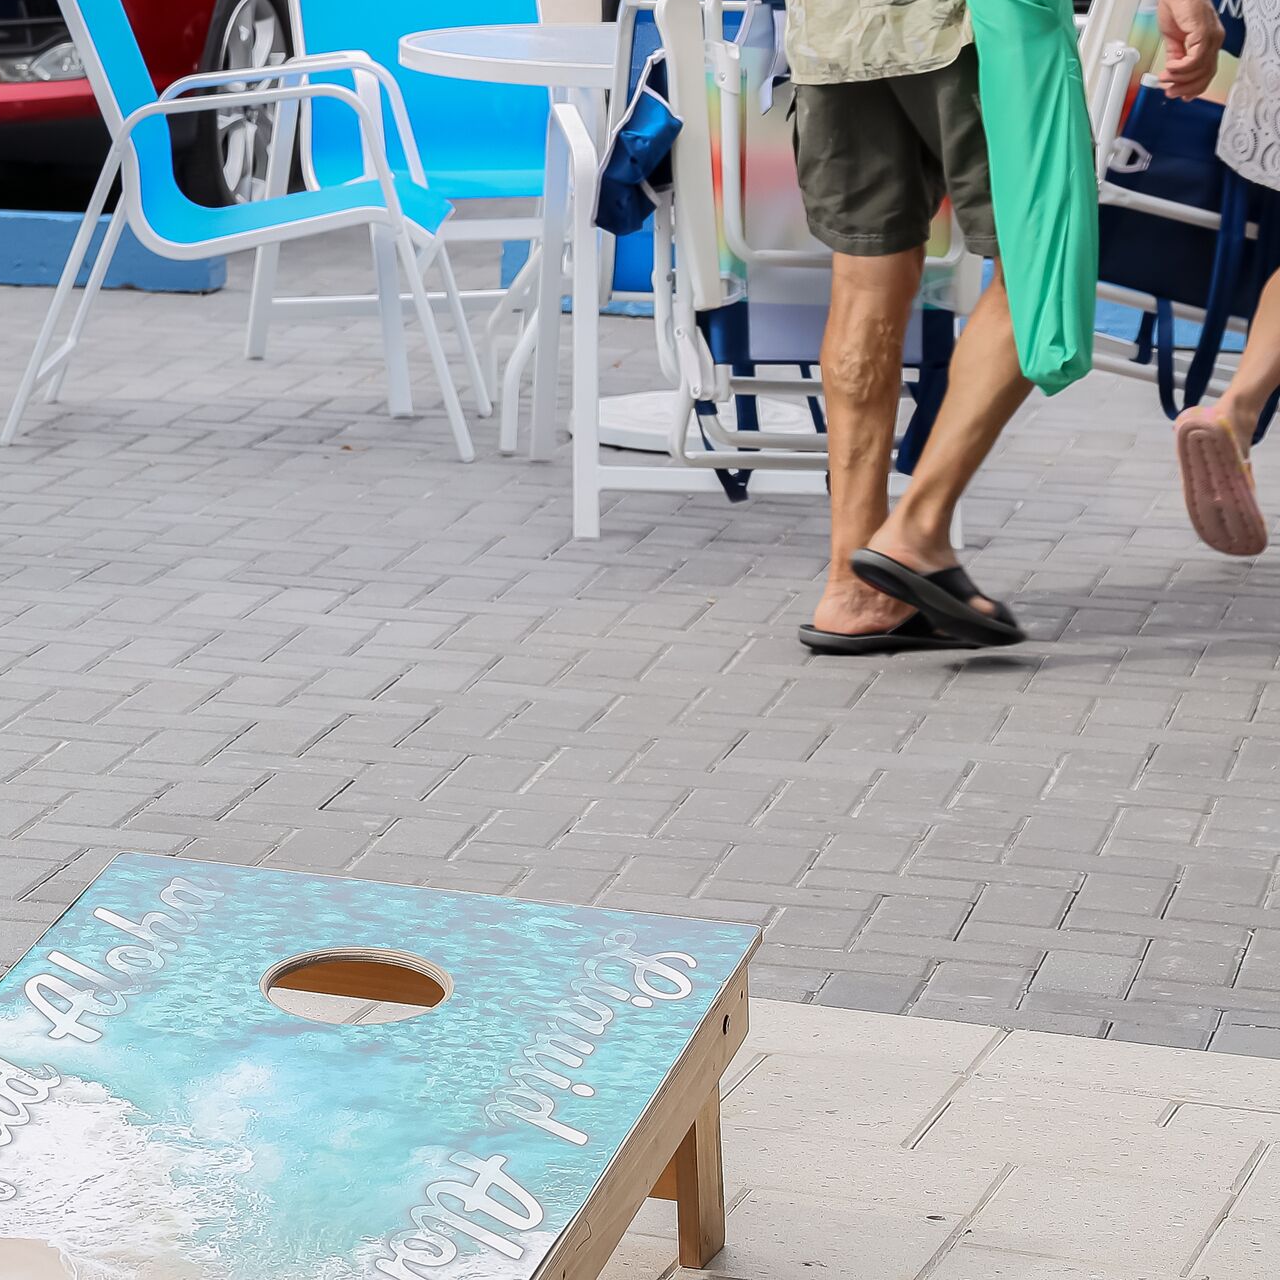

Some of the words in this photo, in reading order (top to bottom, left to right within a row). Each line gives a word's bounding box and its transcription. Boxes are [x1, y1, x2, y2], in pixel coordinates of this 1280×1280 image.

[24, 877, 225, 1043] Aloha
[484, 928, 698, 1146] Liquid
[374, 1150, 545, 1280] Alo
